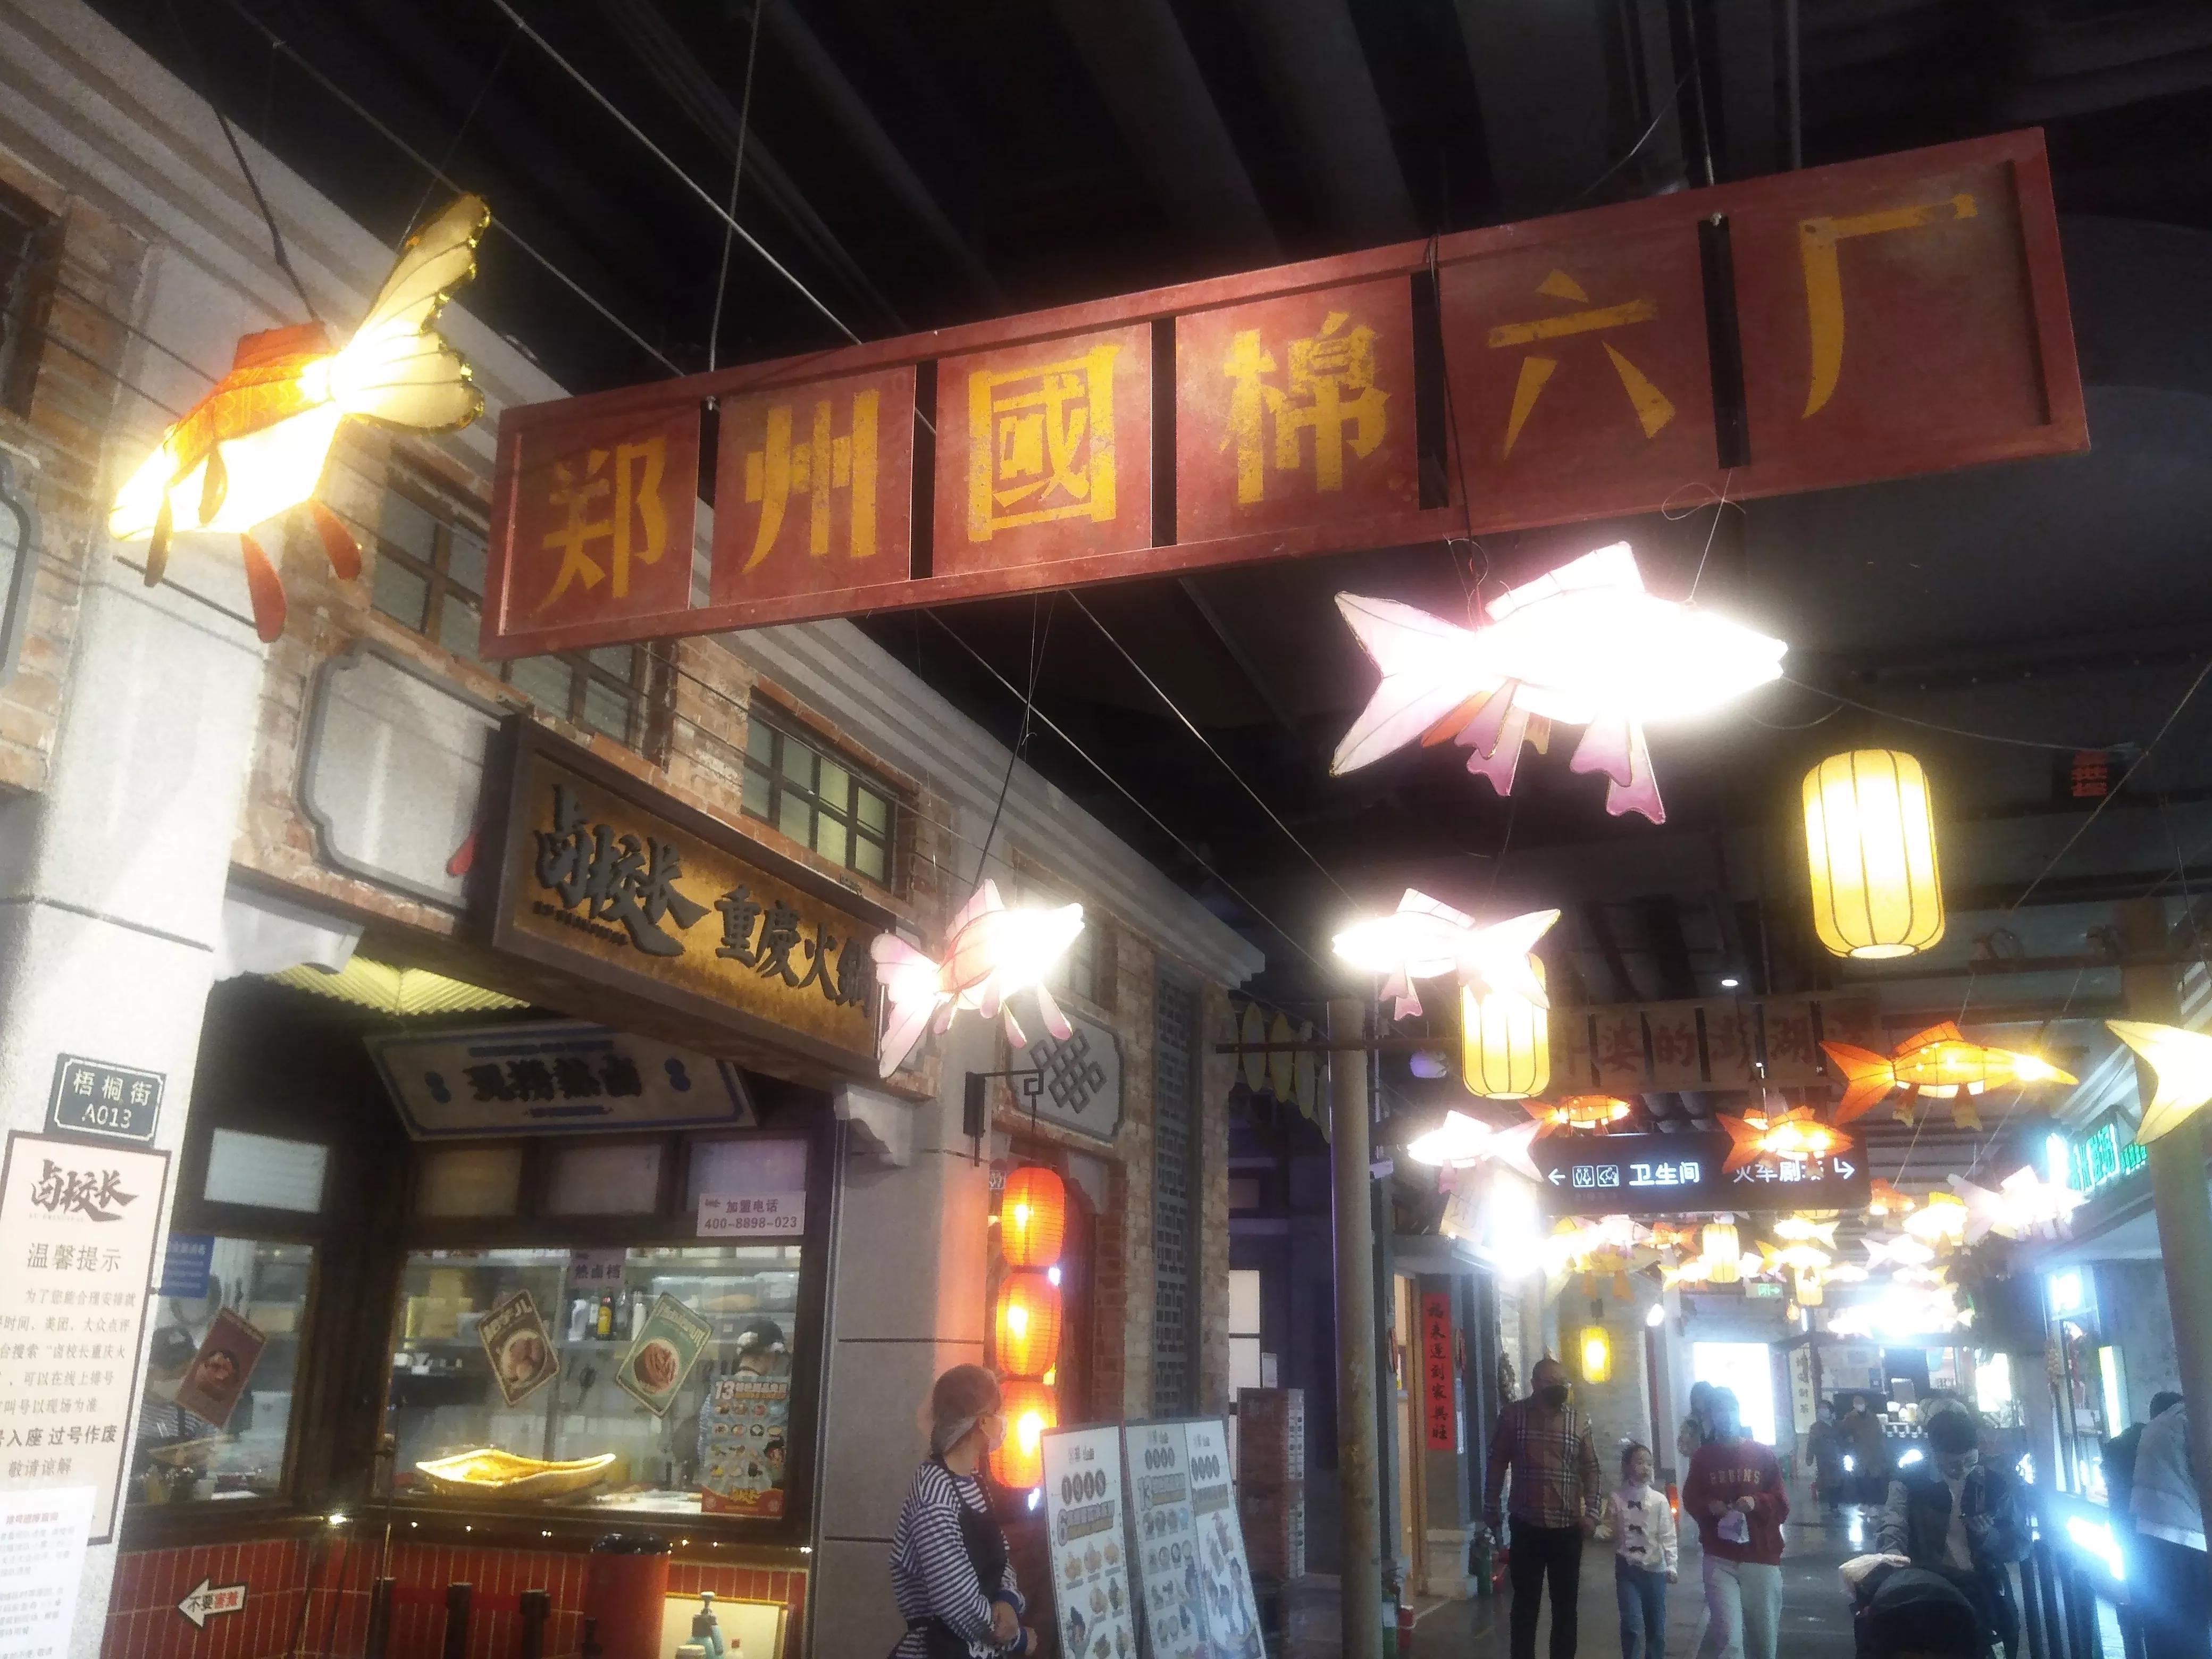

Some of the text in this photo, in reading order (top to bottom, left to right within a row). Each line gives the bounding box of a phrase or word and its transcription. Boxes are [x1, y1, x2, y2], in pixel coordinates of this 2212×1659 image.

[537, 193, 1978, 610] 郑州國棉六厂
[714, 884, 872, 1018] 重慶火鍋
[73, 1069, 152, 1107] 梧桐街
[82, 1105, 132, 1128] A013
[1629, 1161, 1700, 1186] 卫生间
[31, 1159, 139, 1222] 卤校长
[725, 1199, 779, 1214] 加盟电话
[705, 1216, 797, 1229] 400-8898-023
[27, 1243, 121, 1271] 温馨提示
[0, 1397, 97, 1414] 叫号以现场为准
[48, 1425, 117, 1445] 过号作废
[9, 1457, 72, 1477] 敬请谅解
